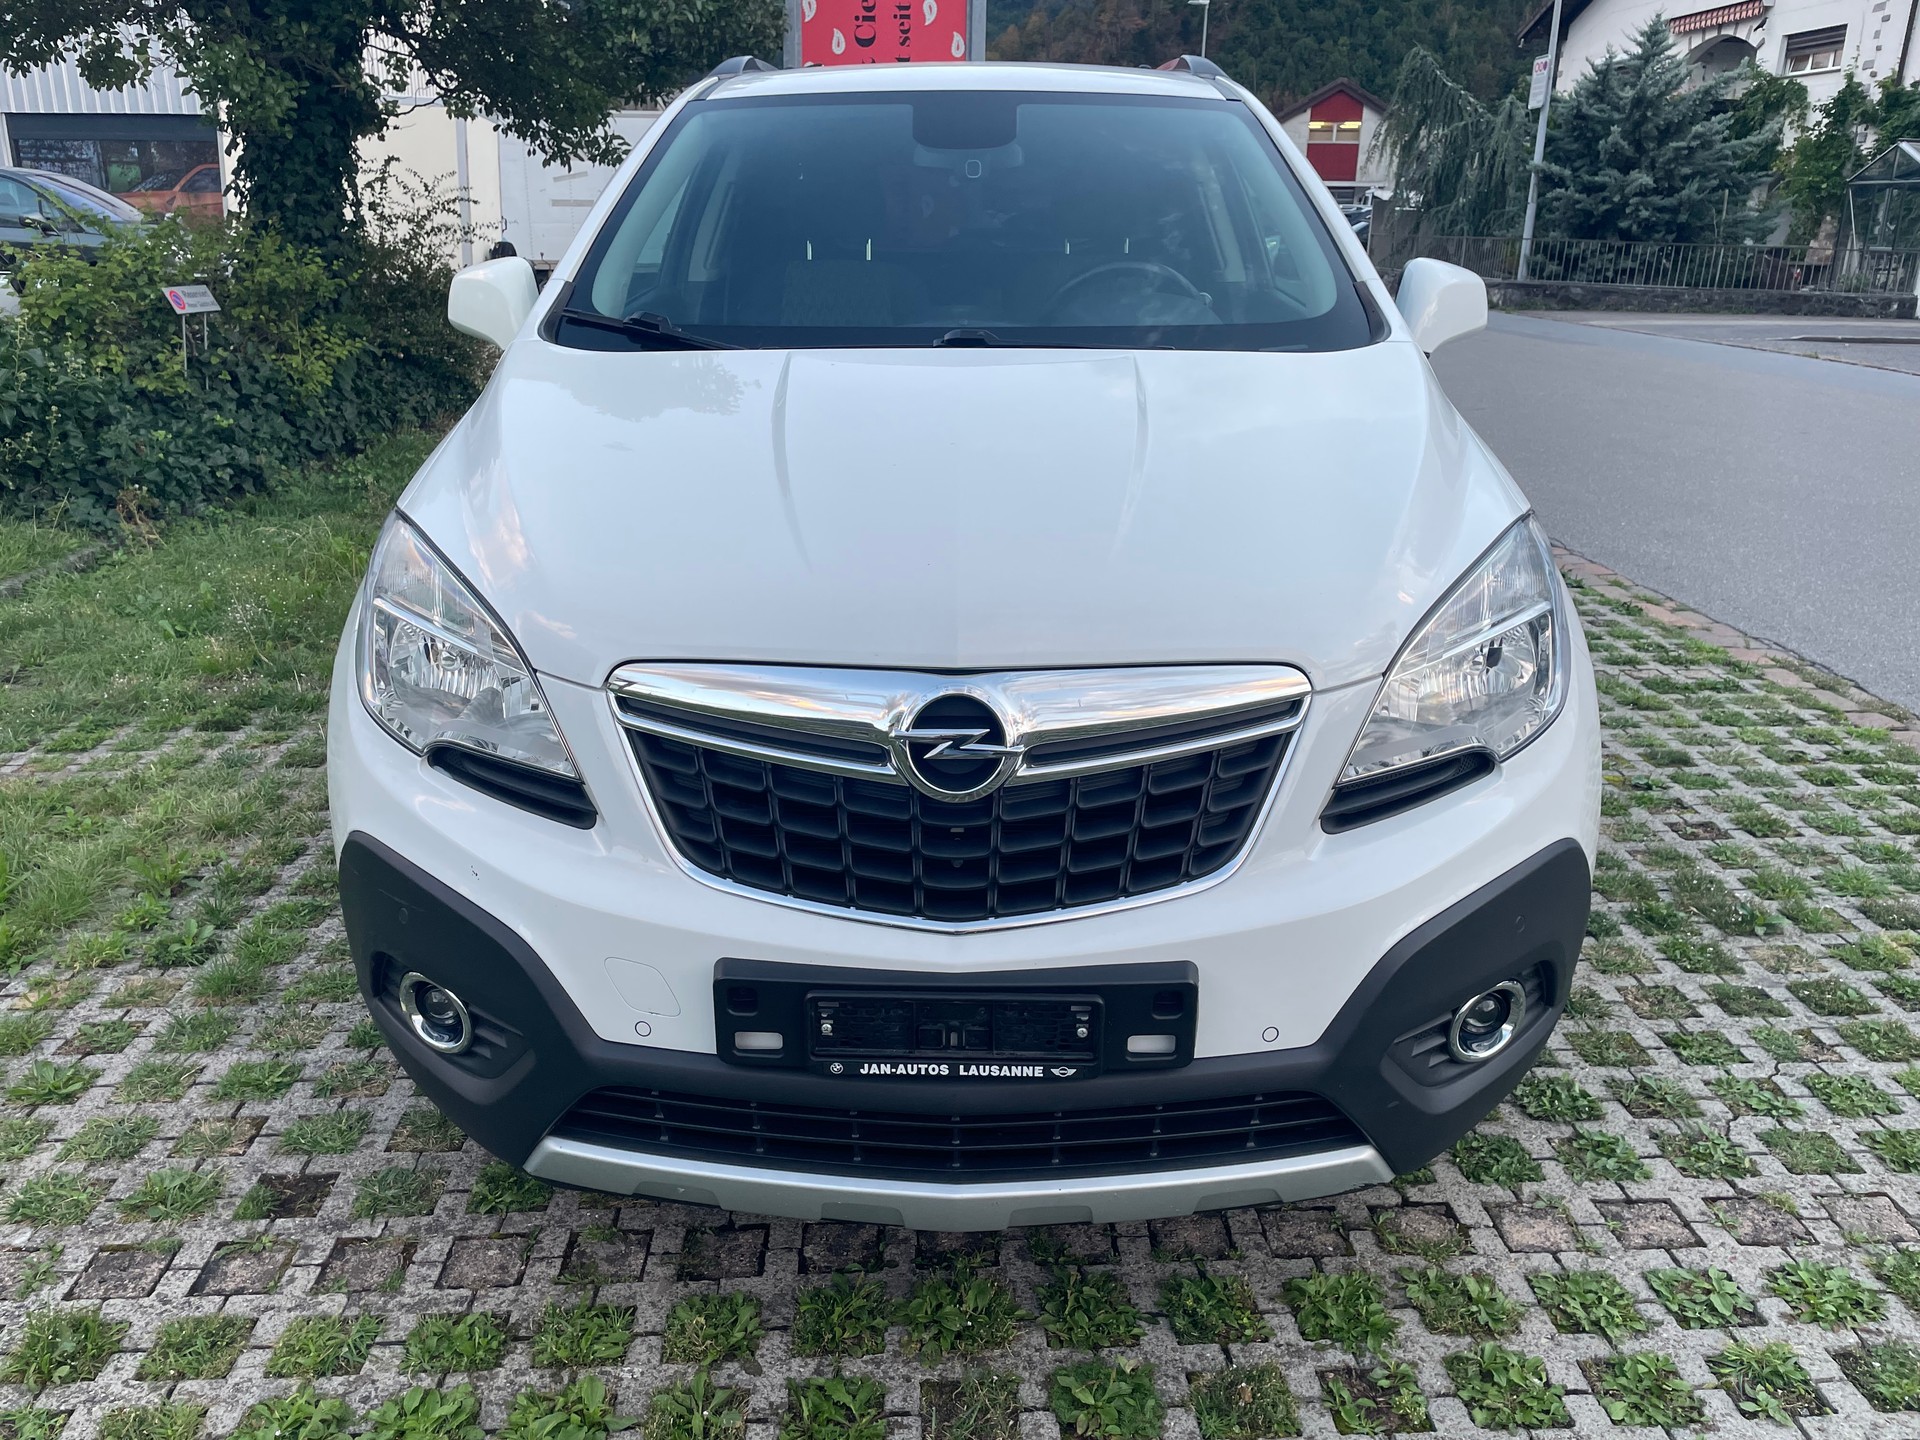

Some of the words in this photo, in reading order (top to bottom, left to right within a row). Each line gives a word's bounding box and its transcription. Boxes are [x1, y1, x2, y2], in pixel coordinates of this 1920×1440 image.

[893, 2, 911, 47] seit
[859, 1063, 950, 1076] JAN-AUTOS
[959, 1064, 1044, 1077] LAUSANNE
